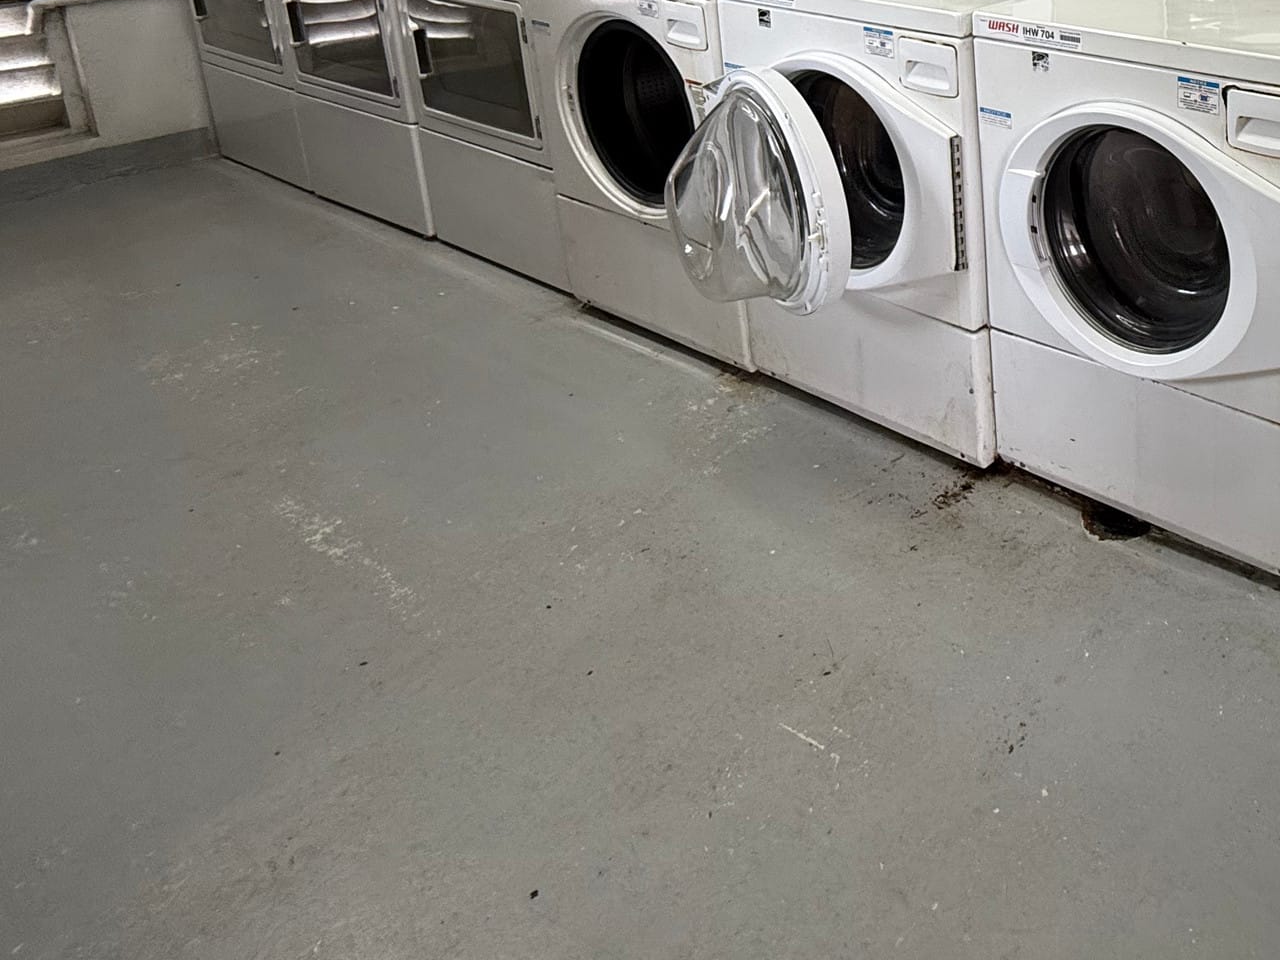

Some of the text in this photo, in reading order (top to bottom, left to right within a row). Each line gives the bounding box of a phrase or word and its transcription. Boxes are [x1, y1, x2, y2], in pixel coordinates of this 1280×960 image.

[988, 19, 1055, 40] WASH IHW 704
